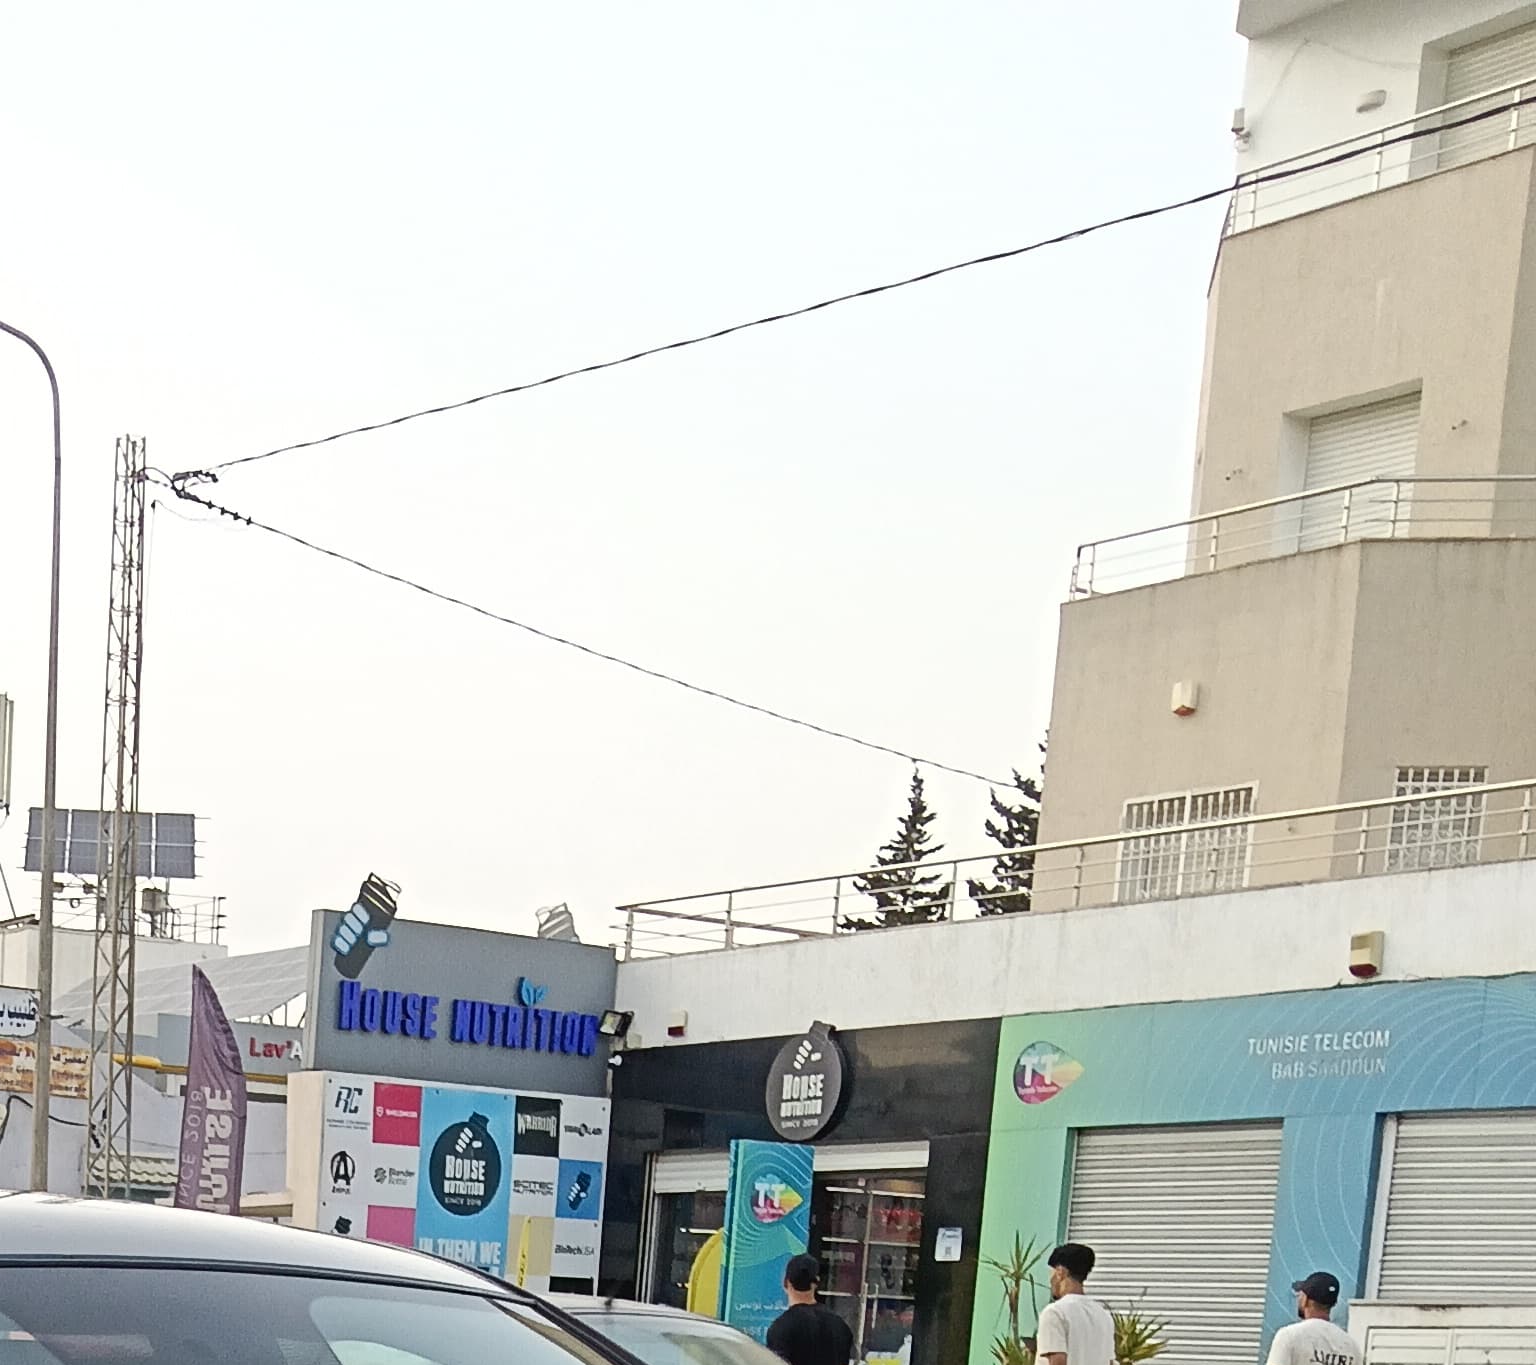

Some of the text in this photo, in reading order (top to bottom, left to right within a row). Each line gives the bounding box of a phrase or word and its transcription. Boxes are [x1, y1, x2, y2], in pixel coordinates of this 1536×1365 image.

[338, 980, 598, 1057] HOUSE NUTRITION
[249, 1037, 303, 1061] Lav'A
[1248, 1030, 1390, 1056] TUNISIE TELECOM
[1020, 1054, 1060, 1086] TT
[1272, 1061, 1304, 1080] BAB
[782, 1073, 824, 1100] HOUSE
[445, 1155, 486, 1181] HOUSE
[755, 1182, 786, 1208] TT
[437, 1238, 477, 1264] THEM
[479, 1241, 501, 1264] WE
